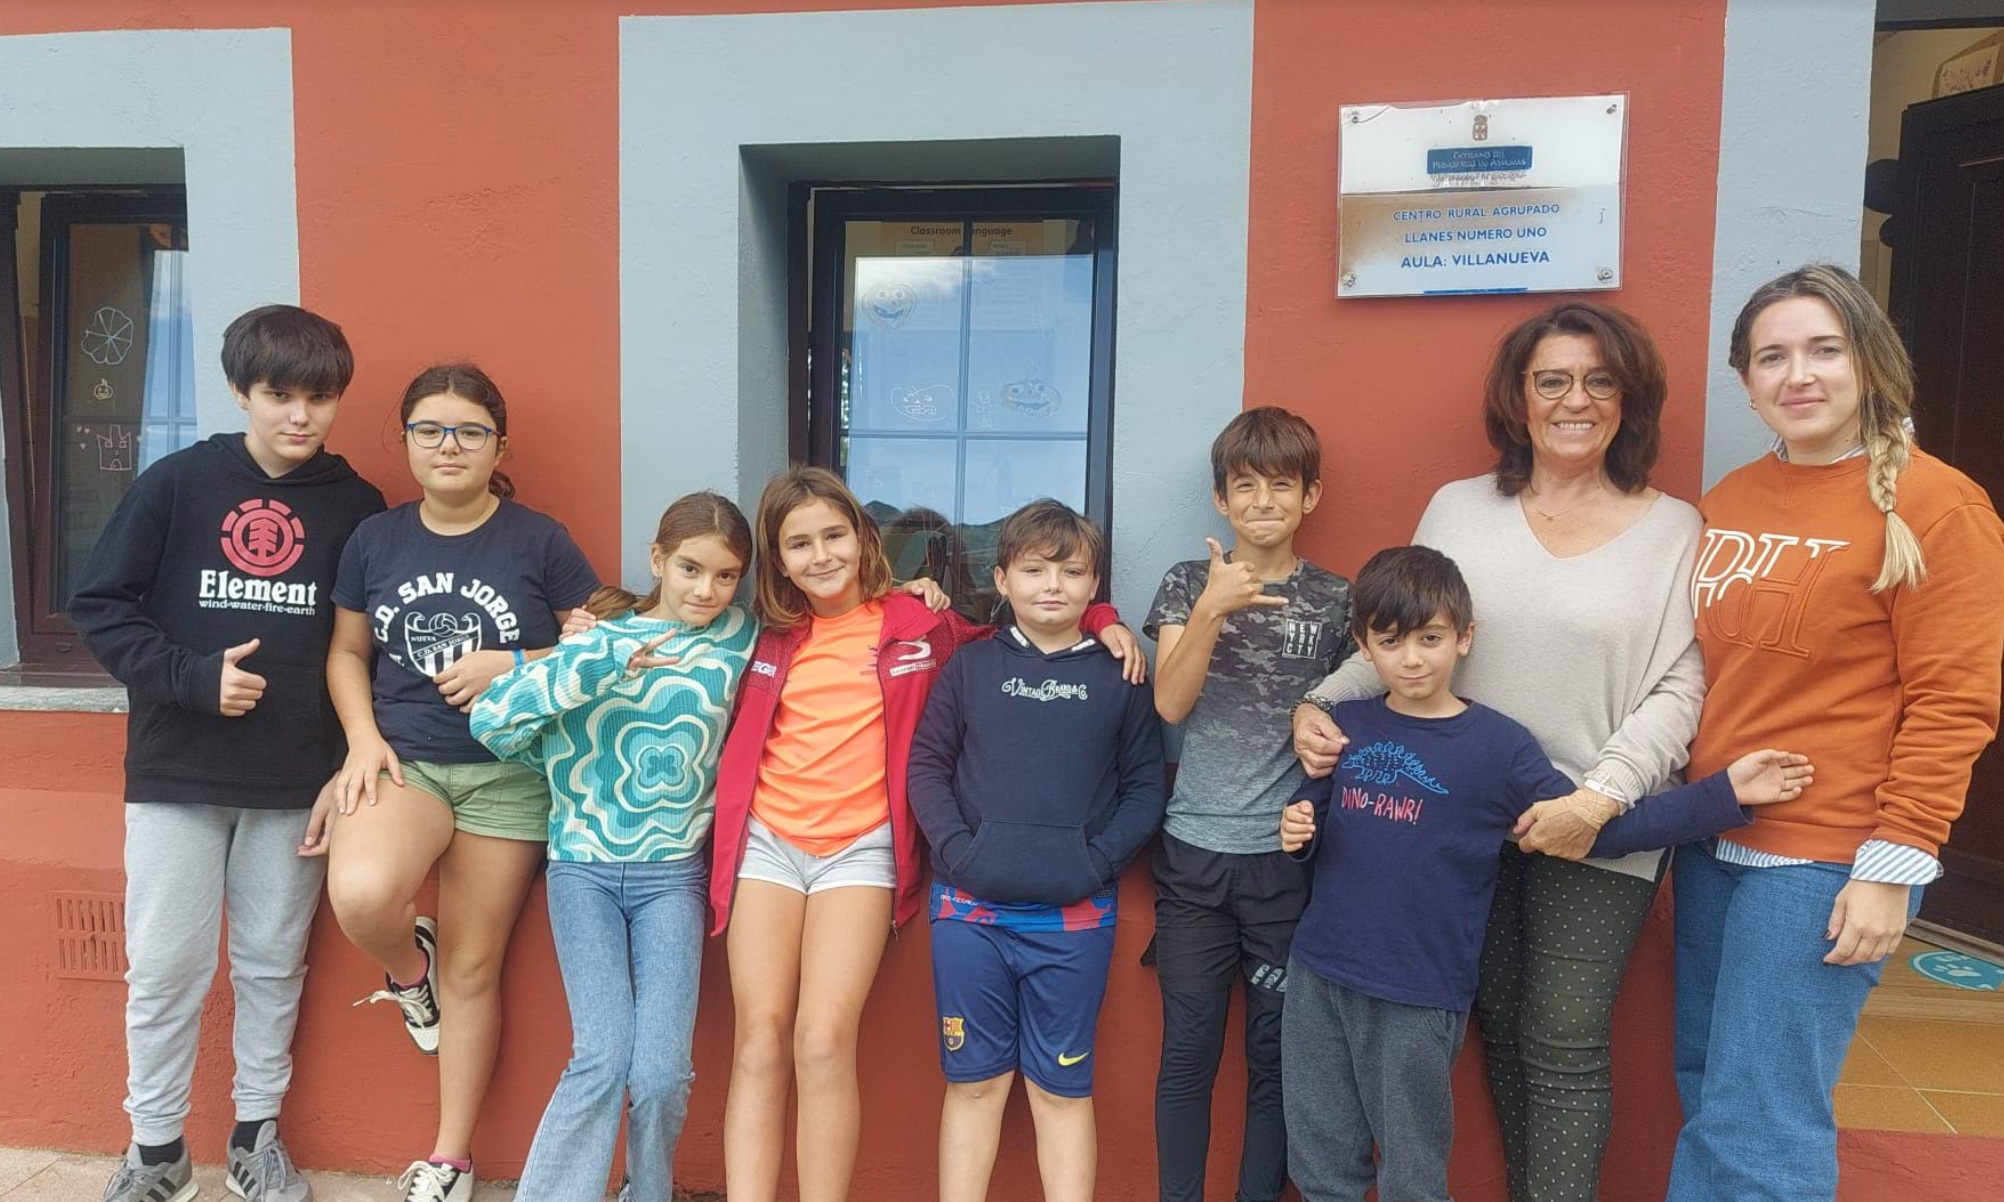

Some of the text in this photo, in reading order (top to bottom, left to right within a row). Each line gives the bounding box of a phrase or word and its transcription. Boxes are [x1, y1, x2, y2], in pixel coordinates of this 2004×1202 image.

[1393, 203, 1560, 221] CENTRO RURAL AGRUPADO
[910, 225, 961, 236] Classroom
[1404, 226, 1547, 244] LLANES NUMERO UNO
[1401, 251, 1550, 269] AULA: VILLANUEVA
[199, 569, 318, 606] Element
[397, 572, 454, 605] SAN
[460, 578, 520, 644] JORGE
[1341, 786, 1424, 826] DINO-RAWR!
